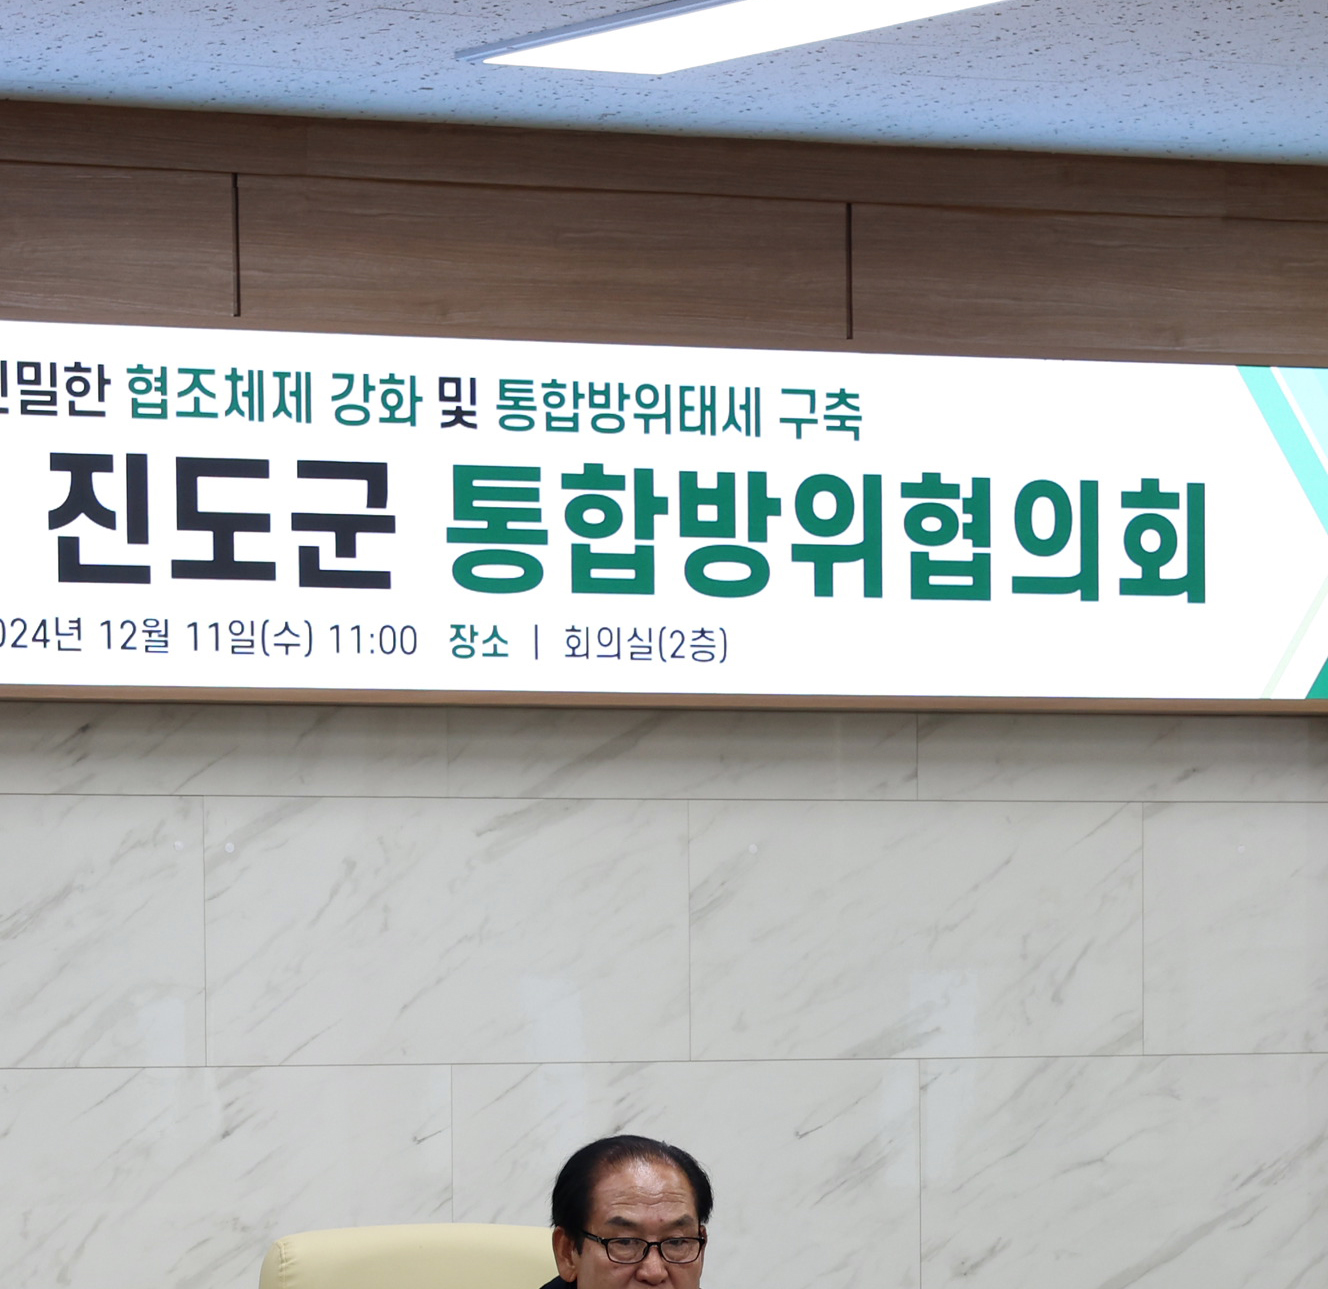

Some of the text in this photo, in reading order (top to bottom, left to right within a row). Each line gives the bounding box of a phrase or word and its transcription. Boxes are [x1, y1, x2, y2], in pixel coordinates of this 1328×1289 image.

[126, 363, 312, 425] 협조체제
[330, 372, 424, 428] 강화
[438, 376, 478, 430] 및
[495, 378, 761, 438] 통합방위태세
[779, 387, 863, 442] 구축
[47, 451, 397, 590] 진도군
[445, 462, 1206, 605] 통합방위협의회
[100, 617, 169, 654] 12월
[186, 619, 313, 658] 11일(수)
[329, 624, 417, 656] 11:00
[449, 623, 728, 664] 장소 회의실(2층)
